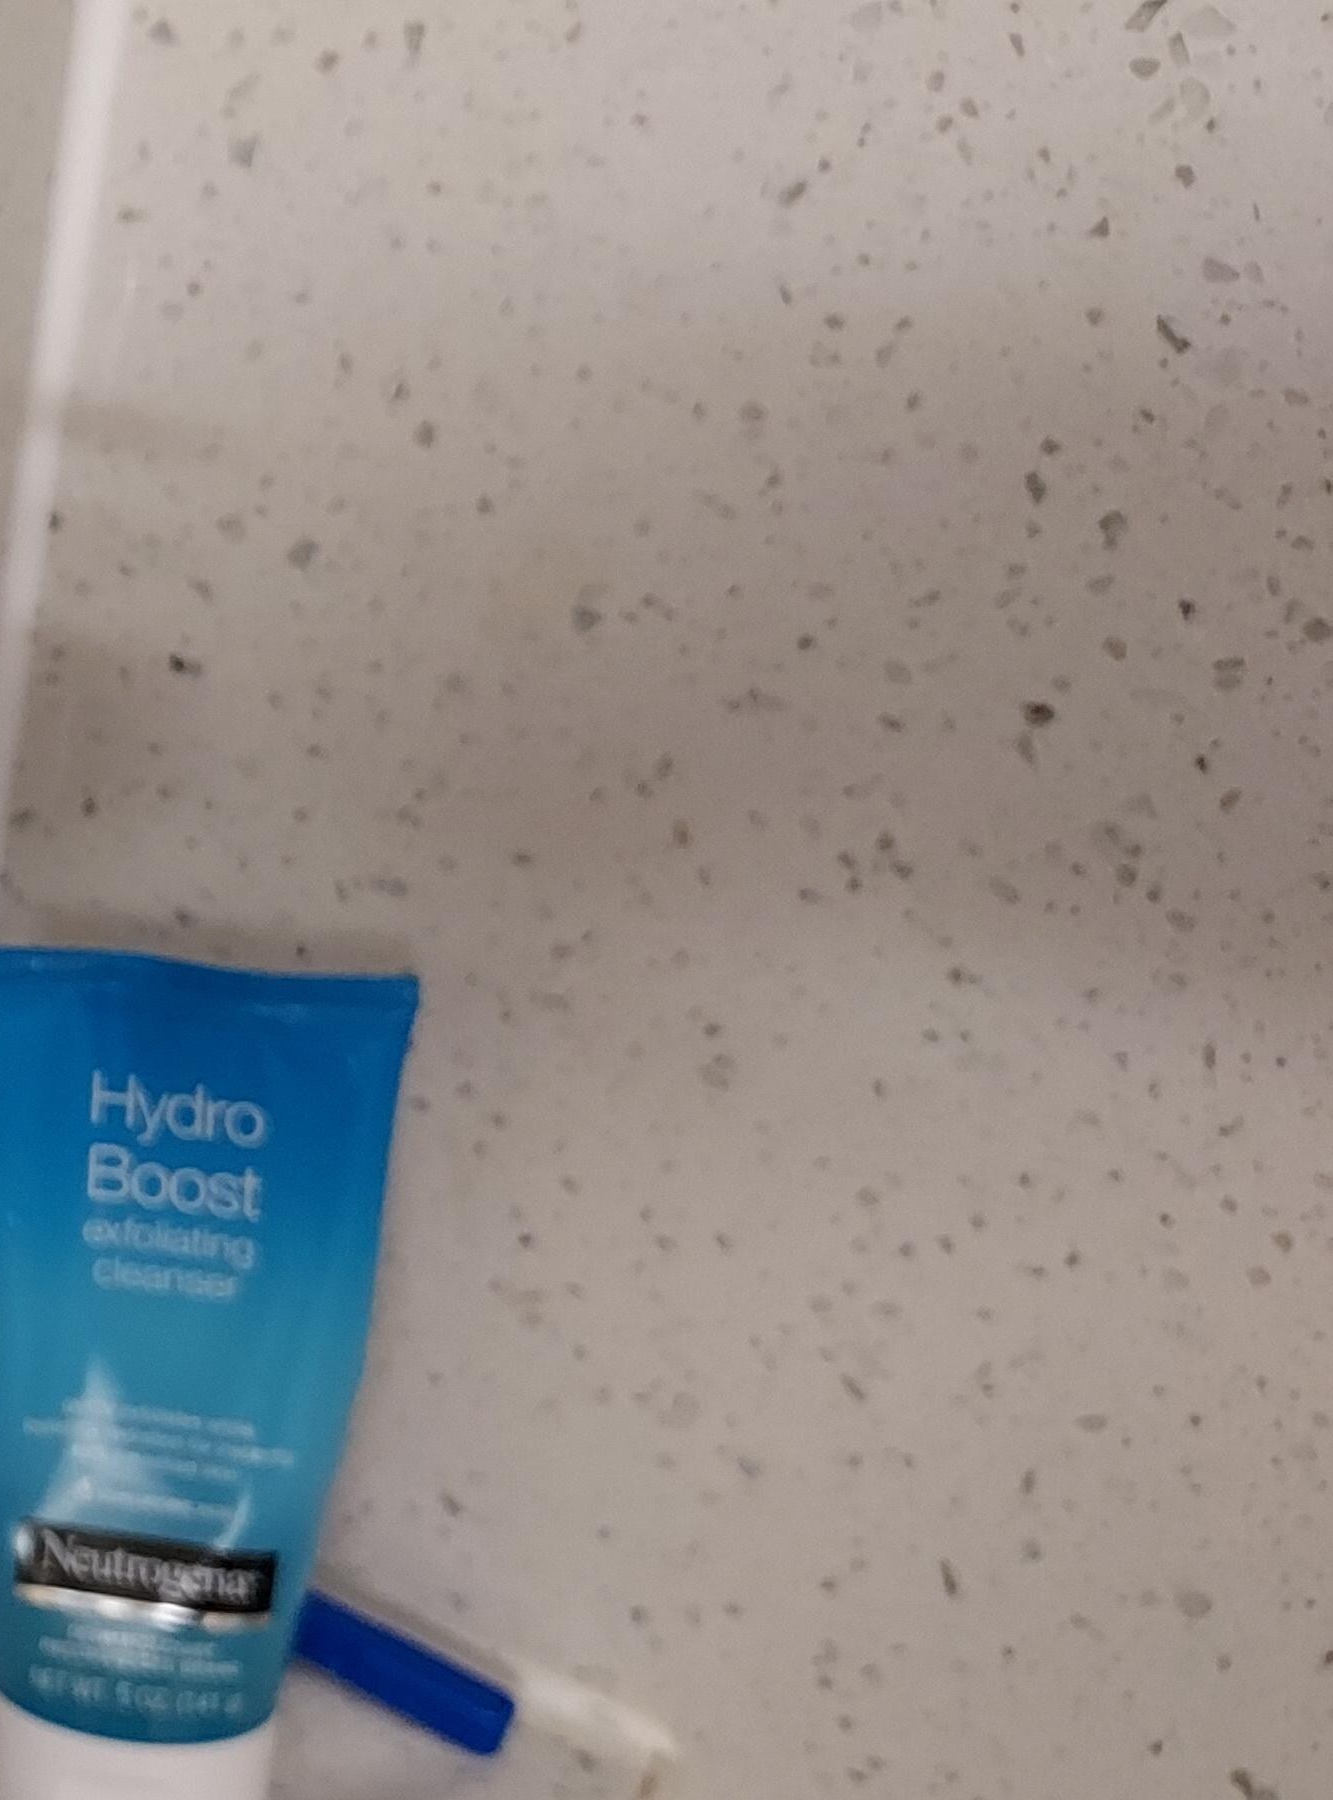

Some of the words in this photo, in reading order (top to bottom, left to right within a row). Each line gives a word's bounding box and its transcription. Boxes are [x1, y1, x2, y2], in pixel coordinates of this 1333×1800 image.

[90, 1068, 268, 1149] Hydro
[86, 1142, 263, 1222] Boost
[82, 1217, 257, 1271] exfoliating
[91, 1256, 243, 1302] cleanser
[42, 1528, 259, 1602] Neutrogena
